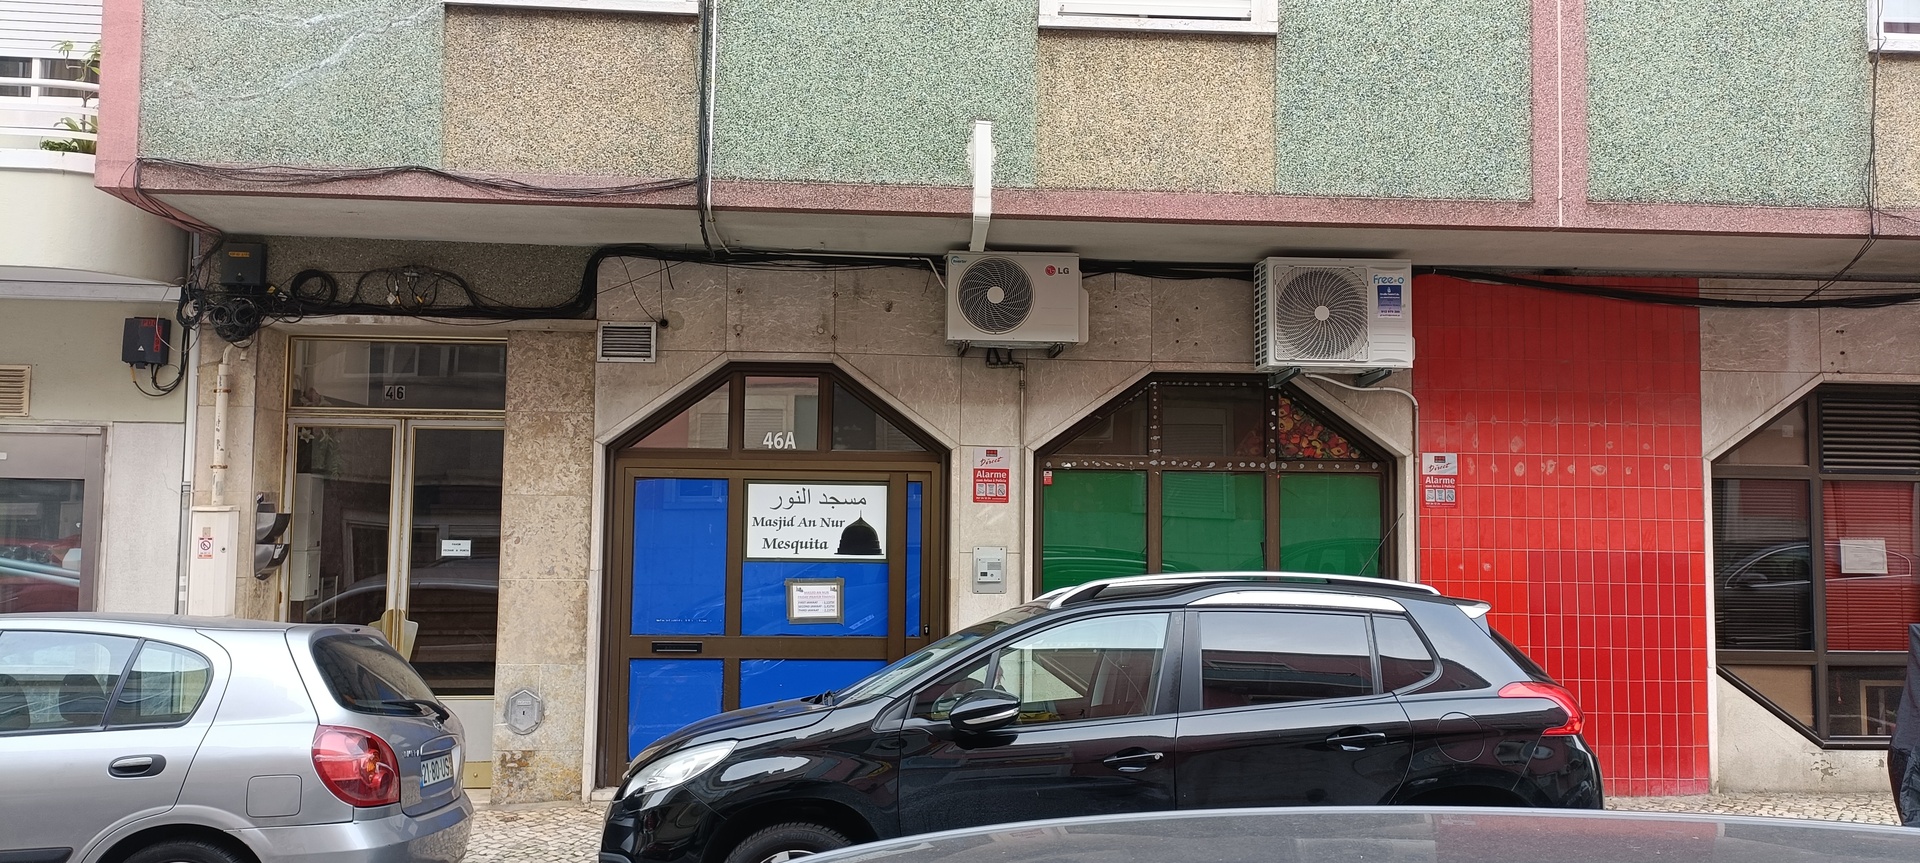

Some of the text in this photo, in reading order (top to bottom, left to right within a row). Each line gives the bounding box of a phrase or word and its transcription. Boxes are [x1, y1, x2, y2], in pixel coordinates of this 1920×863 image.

[1058, 267, 1070, 275] LG
[386, 386, 404, 399] 46
[762, 431, 797, 450] 46A
[976, 470, 1007, 479] Alarme
[1425, 476, 1455, 484] Alarme
[769, 487, 867, 510] مسجد النور
[752, 515, 845, 531] Masjid An Nur
[762, 537, 829, 554] Mesquita
